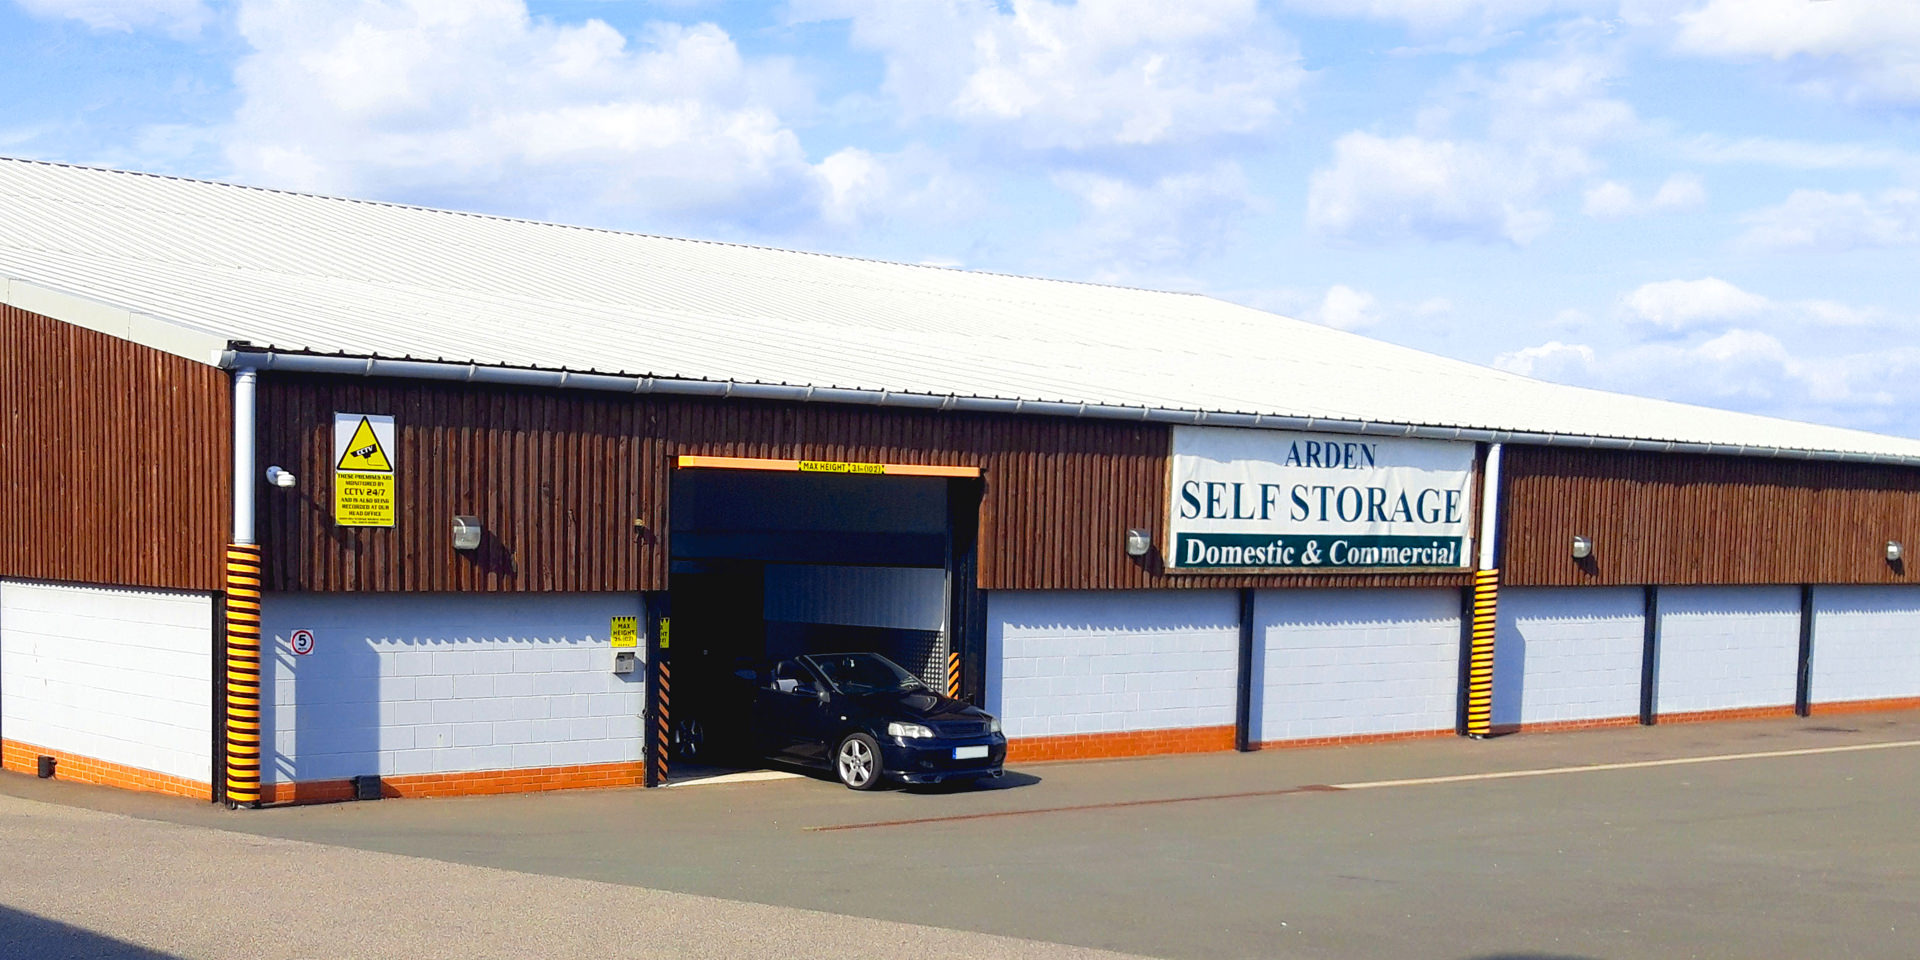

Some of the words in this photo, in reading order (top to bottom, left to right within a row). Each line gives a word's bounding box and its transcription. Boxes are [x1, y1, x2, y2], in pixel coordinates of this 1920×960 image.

[357, 445, 374, 456] CCTV
[1285, 440, 1376, 470] ARDEN
[803, 462, 818, 470] MAX
[820, 463, 846, 472] HEIGHT
[344, 488, 365, 496] CCTV
[1180, 480, 1280, 520] SELF
[1290, 484, 1463, 524] STORAGE
[1184, 538, 1295, 565] Domestic
[1300, 539, 1323, 566] &
[1328, 540, 1457, 566] Commercial
[298, 634, 307, 646] 5
